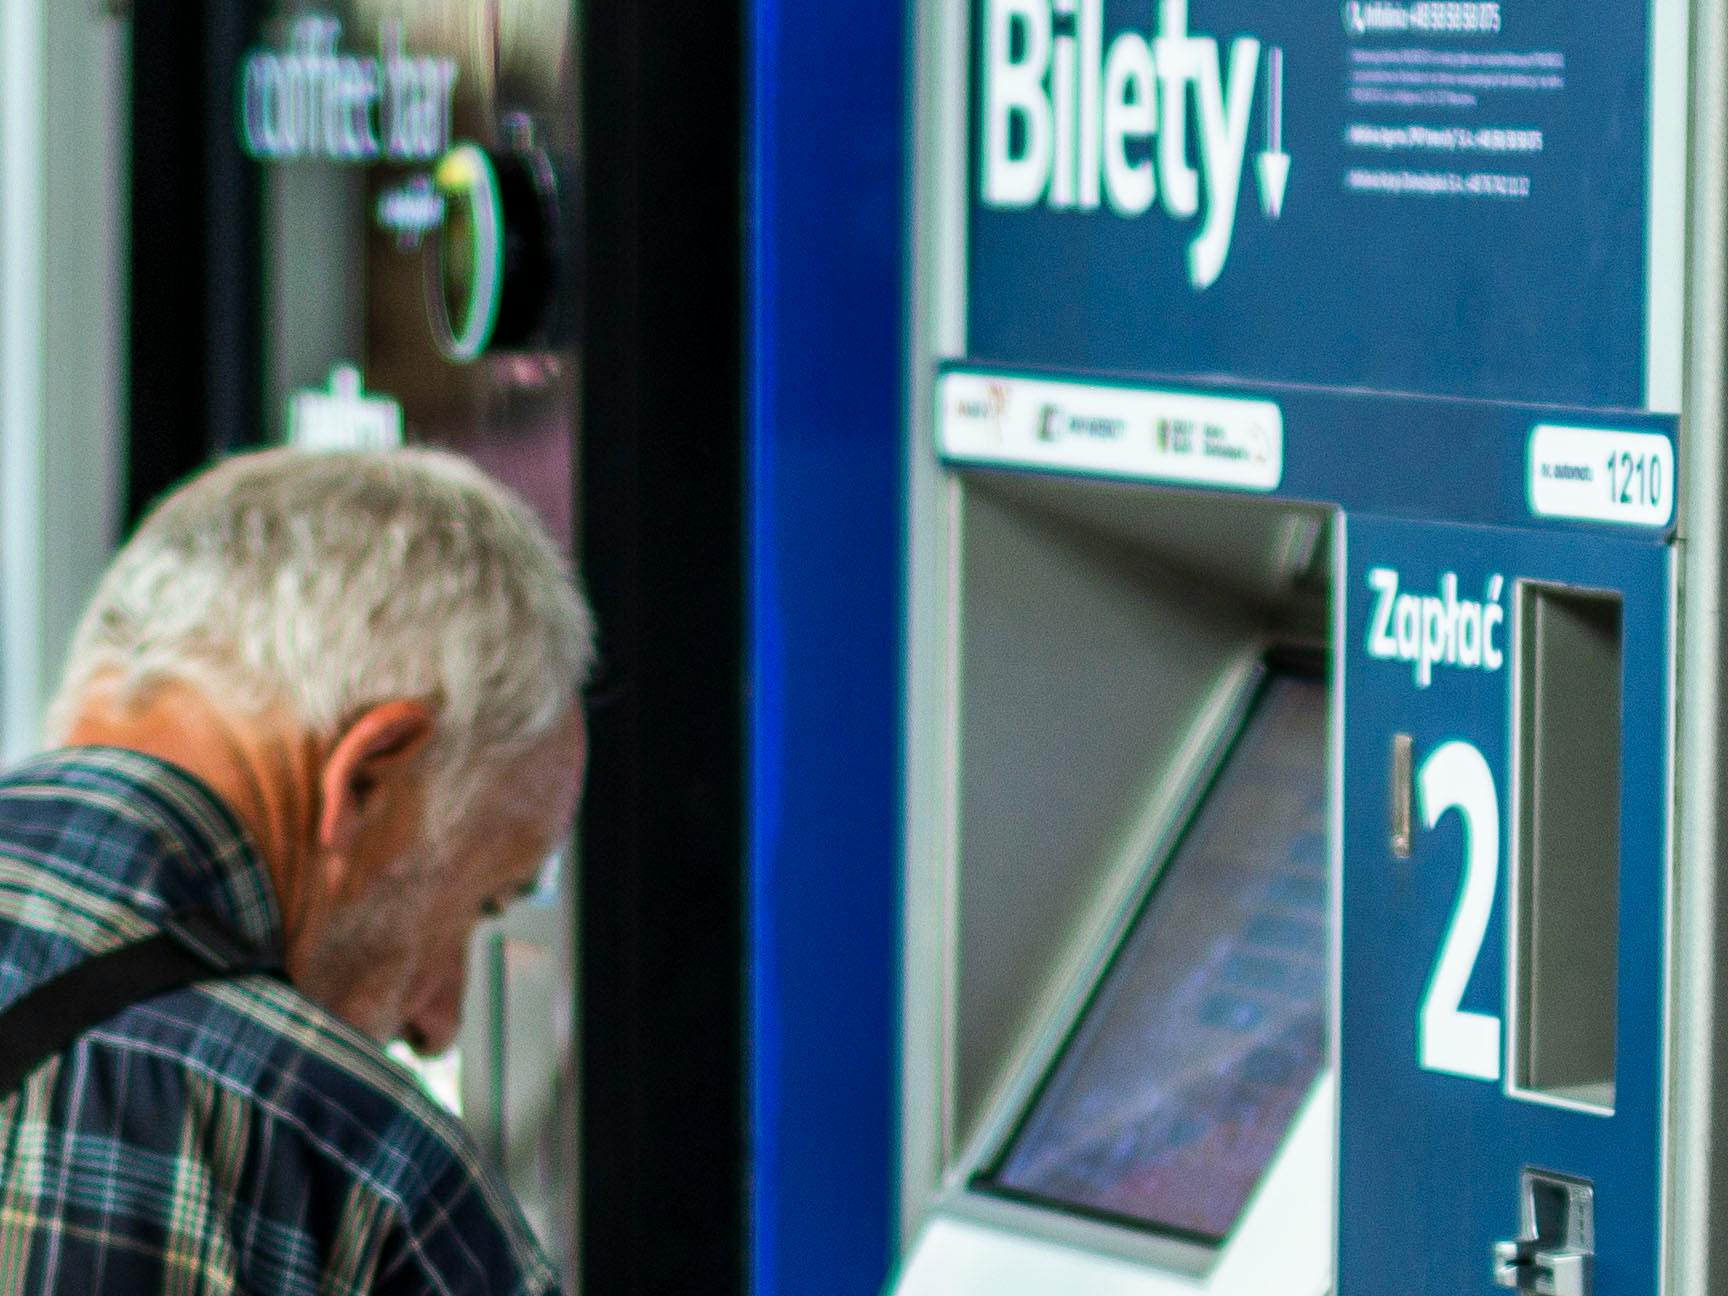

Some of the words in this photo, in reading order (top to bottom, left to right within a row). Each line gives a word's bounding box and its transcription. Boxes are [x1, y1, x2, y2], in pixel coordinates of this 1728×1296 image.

[981, 0, 1260, 290] Bilety
[1606, 449, 1662, 508] 1210
[1370, 567, 1504, 688] Zapłać
[1416, 740, 1501, 1083] 2
